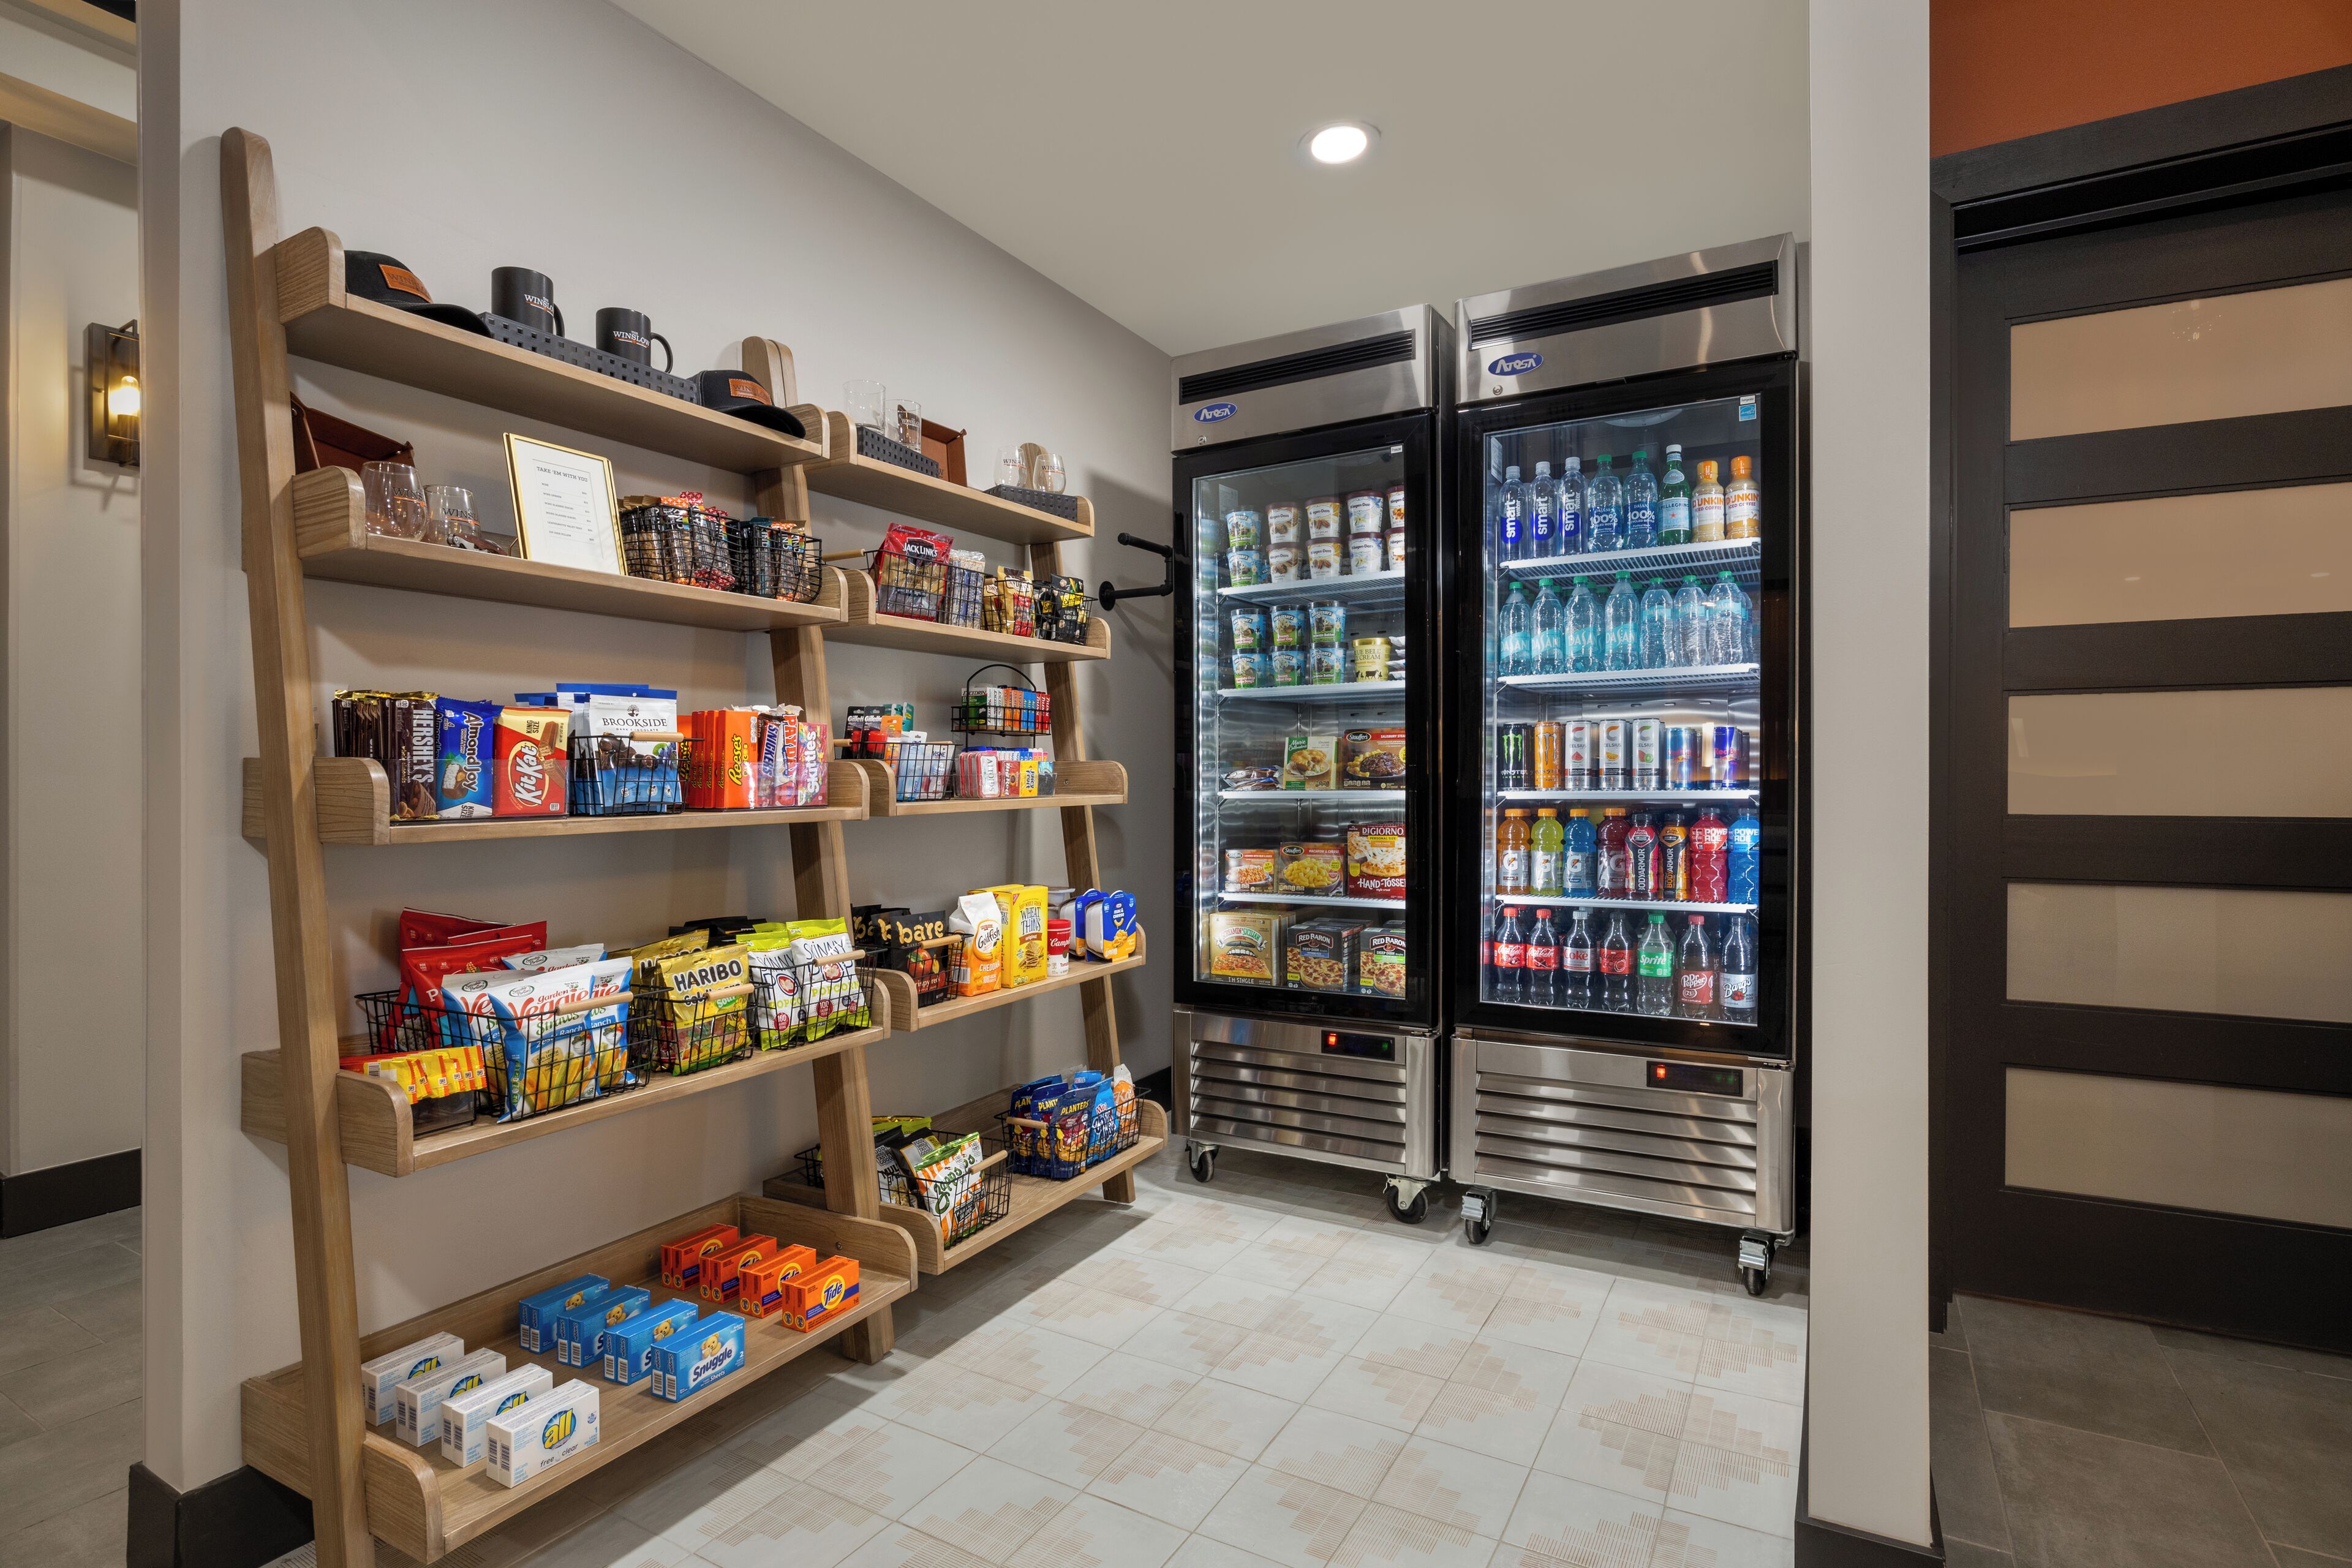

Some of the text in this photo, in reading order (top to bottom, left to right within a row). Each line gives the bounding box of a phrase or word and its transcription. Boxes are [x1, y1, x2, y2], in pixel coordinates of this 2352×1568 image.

[524, 294, 554, 314] WINSLO
[613, 331, 650, 347] WINSLOW
[393, 488, 423, 501] WINS
[1506, 499, 1516, 538] smart
[1537, 496, 1548, 535] smart
[1565, 491, 1575, 531] smart
[1589, 514, 1618, 524] 100%
[1627, 510, 1655, 519] 100%
[902, 542, 920, 554] JACK
[1501, 638, 1530, 654] DASANI
[1531, 637, 1561, 654] DASANI
[1605, 630, 1637, 646] DASANI
[602, 717, 668, 728] BROOKSIDE
[412, 709, 434, 783] HERSHEY'S
[462, 711, 484, 792] Almond Joy
[761, 724, 778, 777] SNICKERS
[727, 733, 743, 786] Reese's
[805, 730, 820, 793] Skittles
[1284, 846, 1303, 855] Stouffer's
[1503, 853, 1518, 871] G
[1566, 854, 1583, 873] G
[1358, 878, 1406, 888] HAND-TOSSE
[1020, 907, 1041, 921] WHEAT
[896, 920, 944, 944] bare
[1020, 918, 1041, 935] THINS
[978, 927, 1001, 949] Goldfish
[1310, 933, 1331, 944] BARON
[1385, 937, 1406, 948] BARON
[804, 938, 846, 960] SKINNY
[1564, 949, 1588, 961] Coke
[979, 960, 1000, 972] CHEDDAR
[1640, 954, 1666, 965] Sprite
[673, 959, 742, 993] HARIBO
[1681, 974, 1706, 988] Pepper
[811, 980, 859, 998] POPCORN
[1723, 976, 1752, 998] Barq's
[537, 988, 570, 1005] garden
[769, 996, 801, 1009] POPCO
[507, 989, 589, 1030] Veggie
[535, 1012, 580, 1036] Straws
[559, 1025, 583, 1040] Ranch
[1014, 1097, 1031, 1110] PLAN
[1038, 1098, 1058, 1112] PLANT
[1060, 1099, 1090, 1116] PLANTERS
[823, 1281, 843, 1308] Tide
[692, 1348, 733, 1382] Snuggle
[710, 1369, 726, 1382] Sheets
[543, 1408, 574, 1450] all
[540, 1443, 579, 1468] free clear
